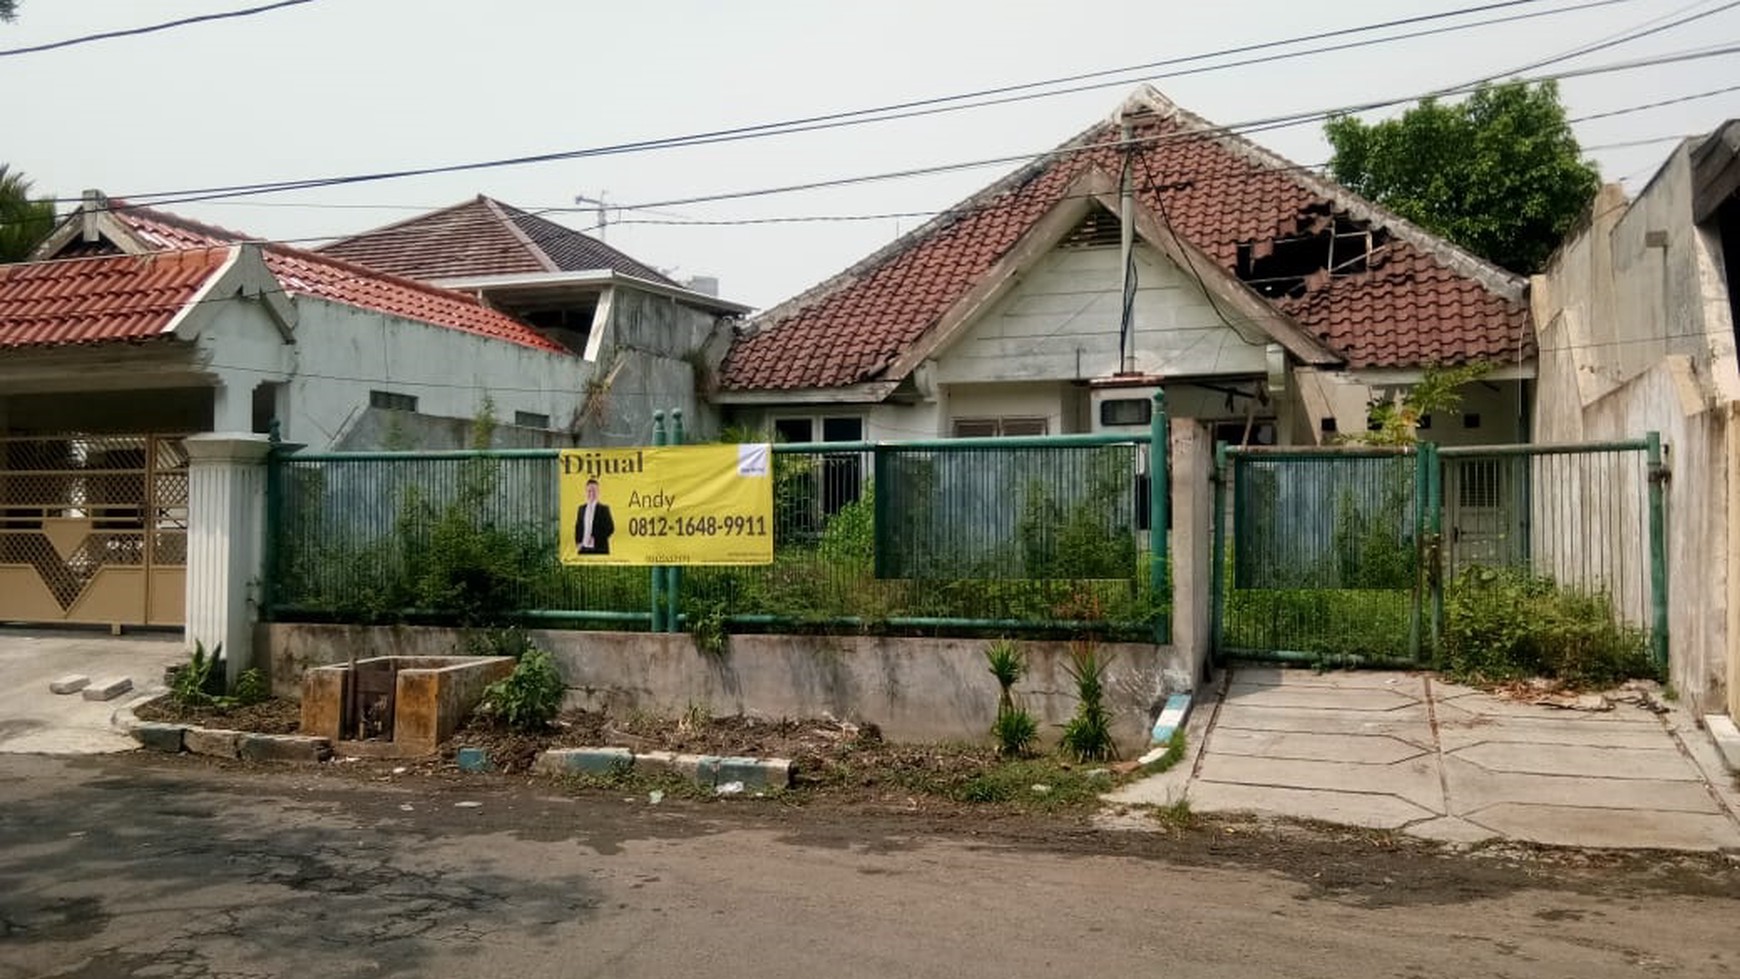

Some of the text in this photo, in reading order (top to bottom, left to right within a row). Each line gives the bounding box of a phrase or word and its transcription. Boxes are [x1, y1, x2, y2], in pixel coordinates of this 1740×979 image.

[562, 452, 643, 479] Dijual
[628, 489, 676, 512] Andy
[628, 516, 767, 537] 0812-1648-9911
